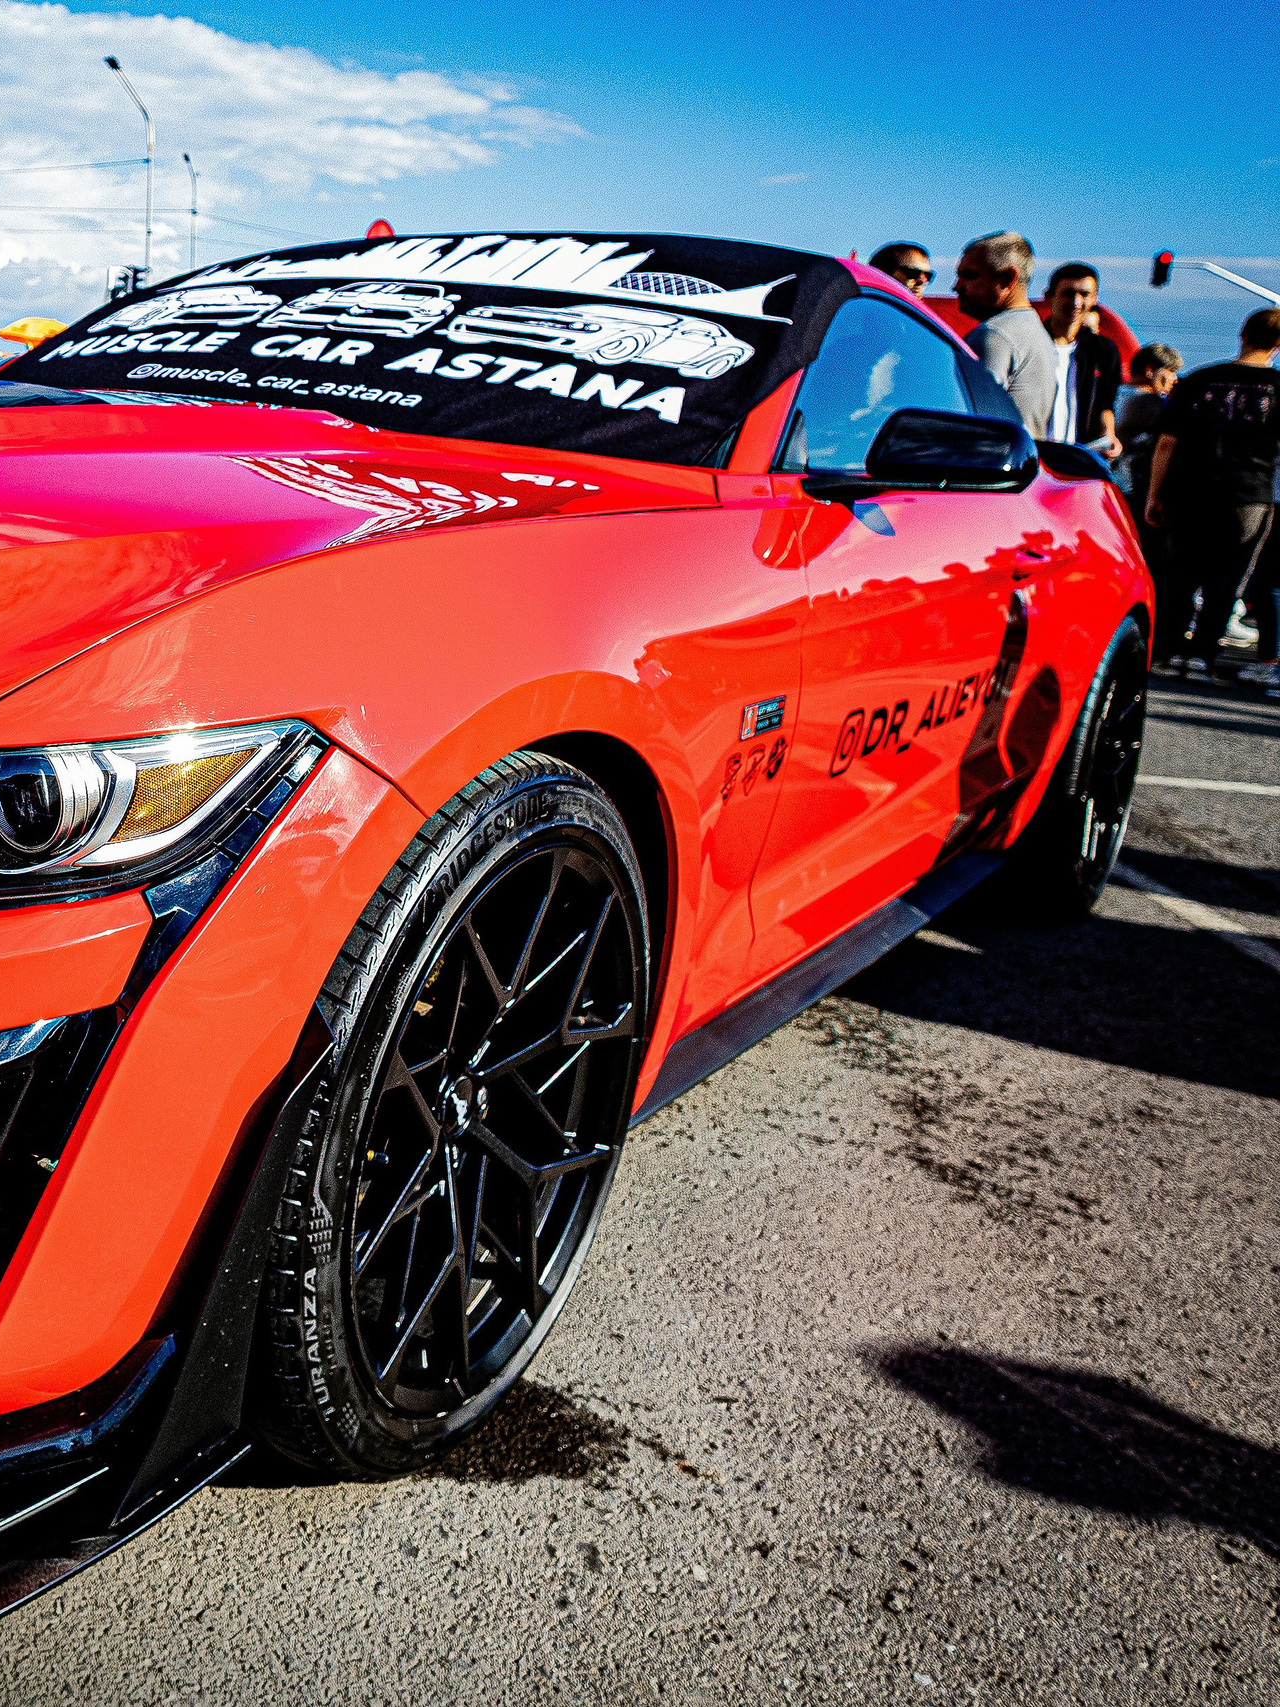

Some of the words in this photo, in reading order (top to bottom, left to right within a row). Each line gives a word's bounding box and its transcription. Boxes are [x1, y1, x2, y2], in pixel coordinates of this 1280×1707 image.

[39, 331, 240, 362] MUSCLE
[250, 334, 375, 366] CAR
[383, 347, 687, 425] ASTANA
[304, 1266, 337, 1422] TURANZA
